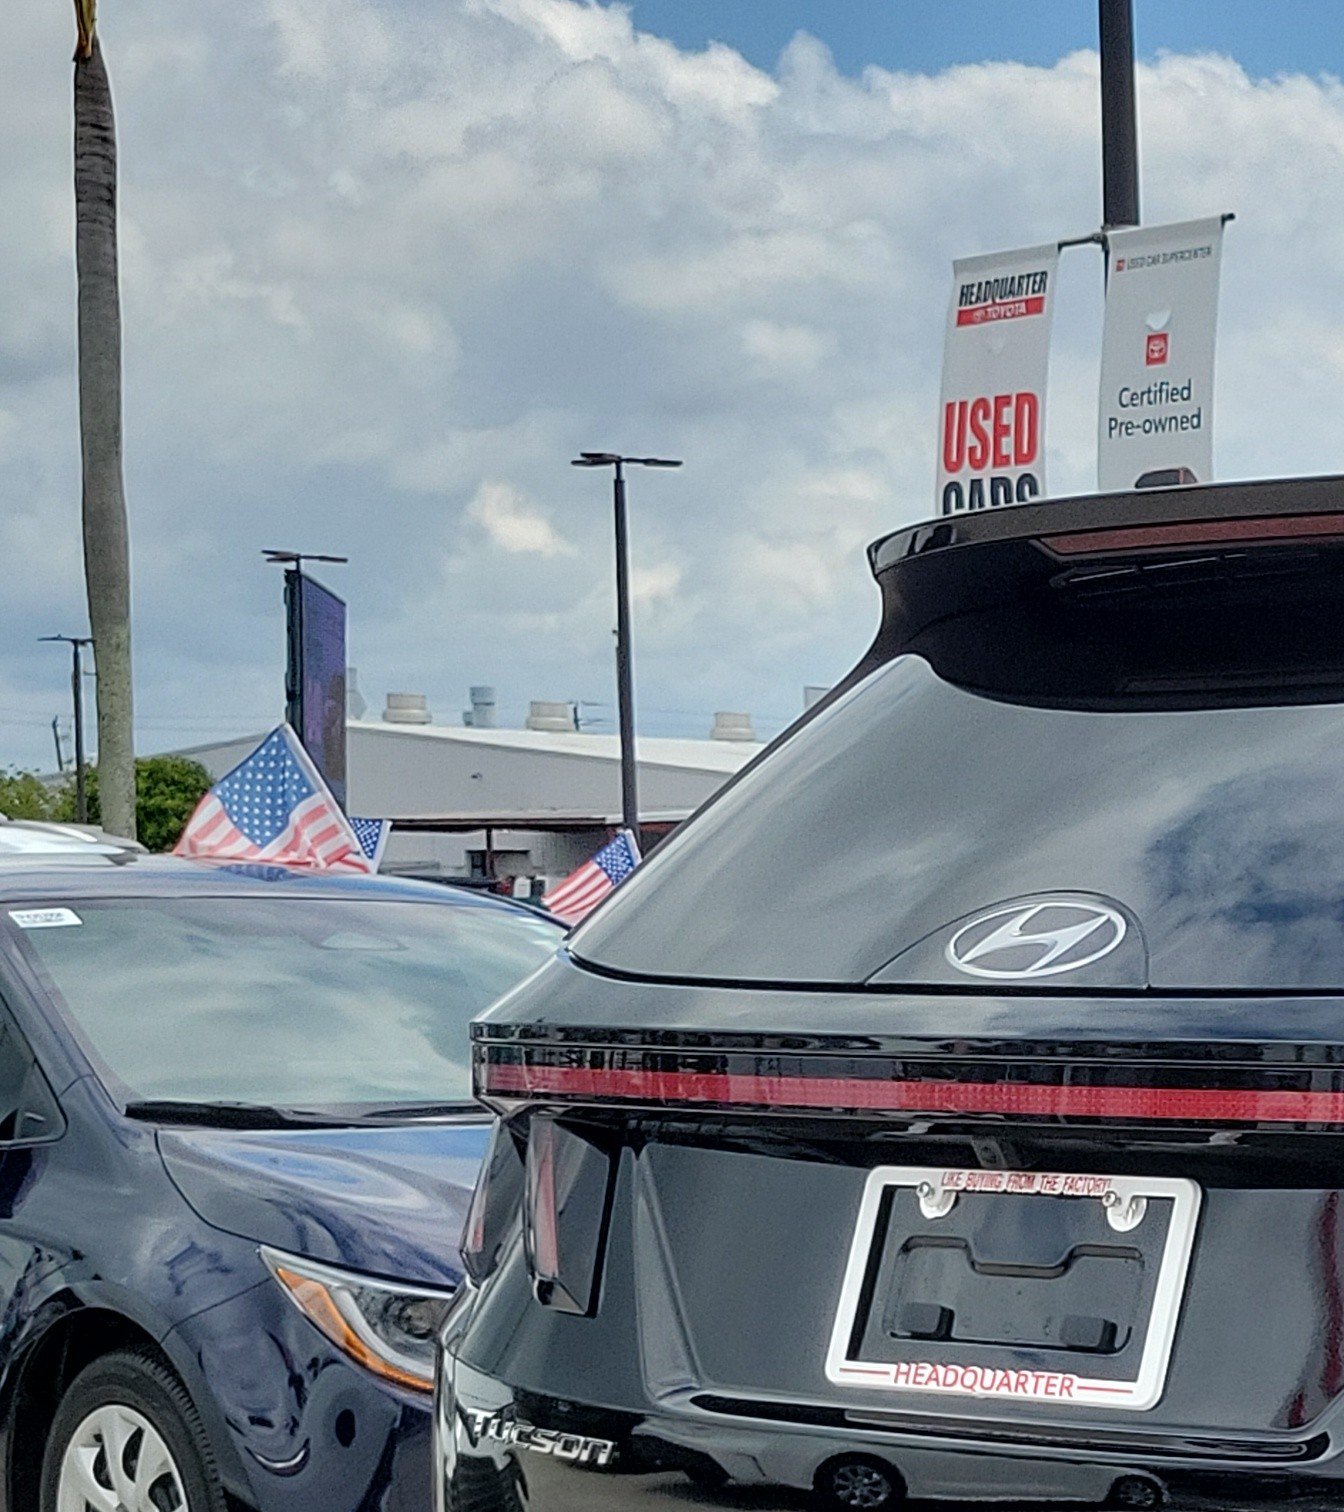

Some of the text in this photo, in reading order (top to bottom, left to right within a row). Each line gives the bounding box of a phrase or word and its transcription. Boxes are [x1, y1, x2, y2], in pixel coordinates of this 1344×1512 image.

[959, 271, 1048, 307] HEADQUARTER
[1118, 380, 1192, 408] Certified
[943, 392, 1038, 473] USED
[1108, 408, 1201, 439] Pre-owned
[941, 1171, 963, 1187] LIKE
[966, 1172, 1004, 1189] BUYING
[1006, 1173, 1036, 1190] FROM
[1040, 1175, 1059, 1190] THE
[893, 1363, 1074, 1397] HEADQUARTER
[467, 1407, 615, 1465] TUCSON
